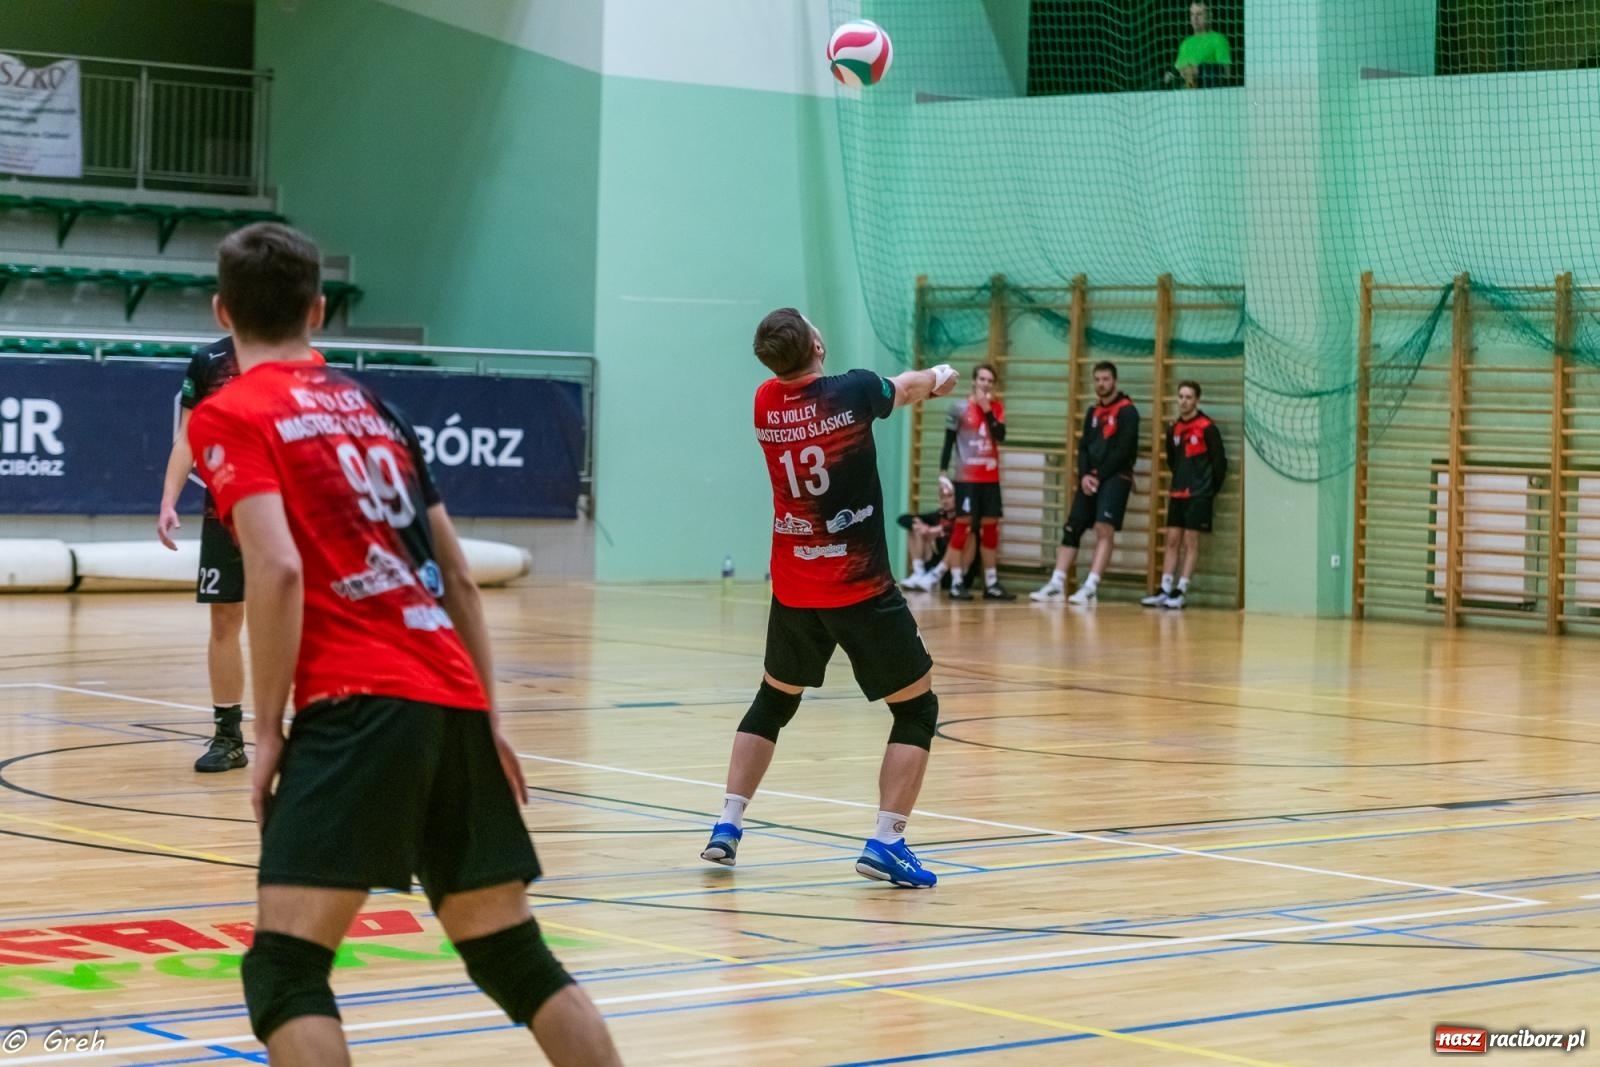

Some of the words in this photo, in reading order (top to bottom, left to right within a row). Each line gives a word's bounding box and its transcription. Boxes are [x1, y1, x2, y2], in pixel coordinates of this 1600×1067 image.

[767, 409, 781, 425] KS
[781, 402, 817, 424] VOLLEY
[807, 409, 855, 438] ŚLĄSKIE
[336, 442, 416, 529] 99
[779, 445, 830, 499] 13
